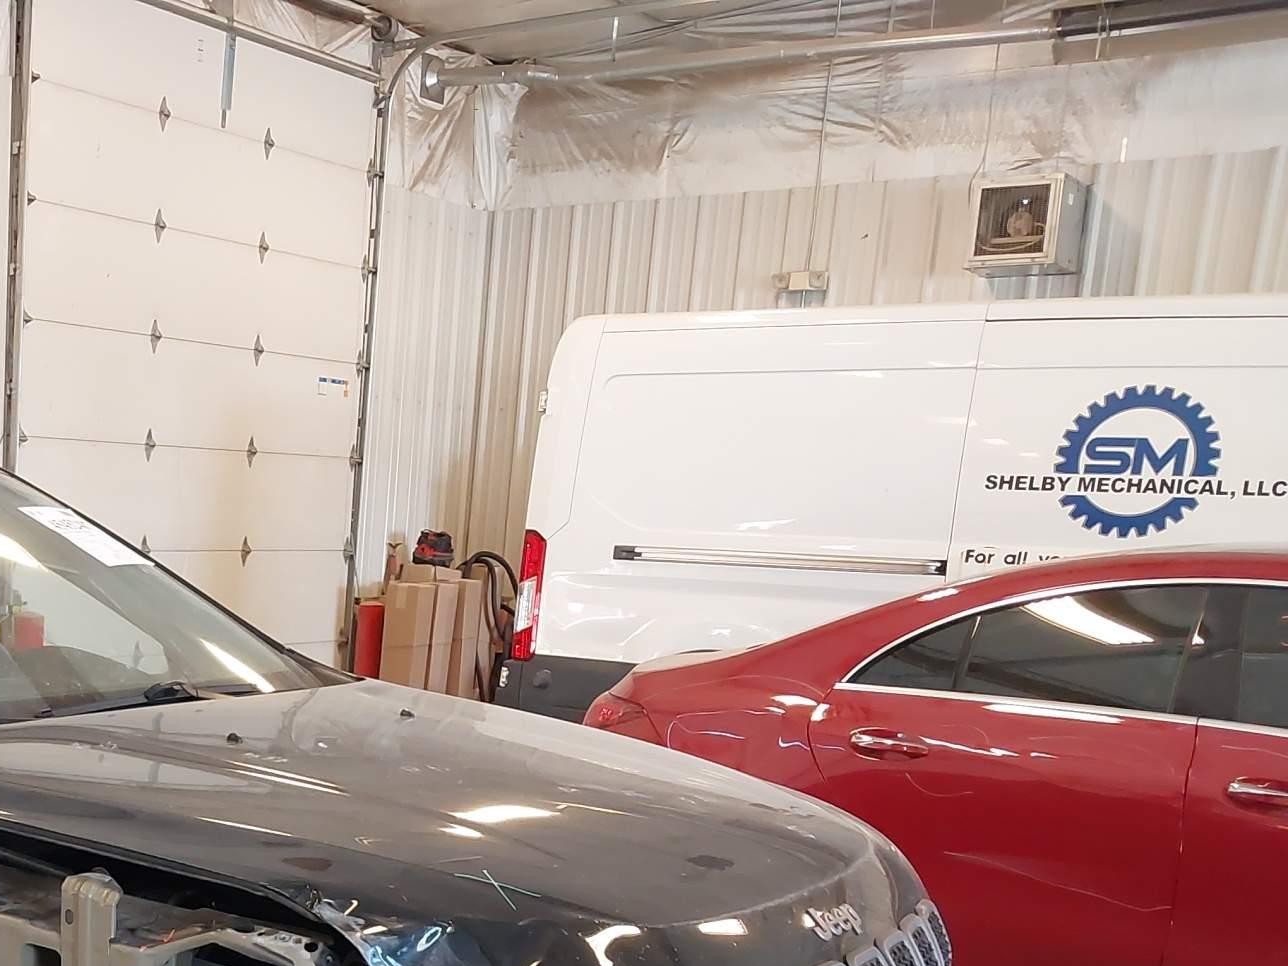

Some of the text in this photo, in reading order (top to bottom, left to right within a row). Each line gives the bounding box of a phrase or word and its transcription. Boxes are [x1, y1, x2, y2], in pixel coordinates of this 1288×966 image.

[1082, 436, 1190, 476] SM
[984, 474, 1288, 500] SHELBY MECHANICAL, LLC
[964, 548, 996, 565] For
[1003, 551, 1029, 566] all
[806, 903, 864, 942] Jeep
